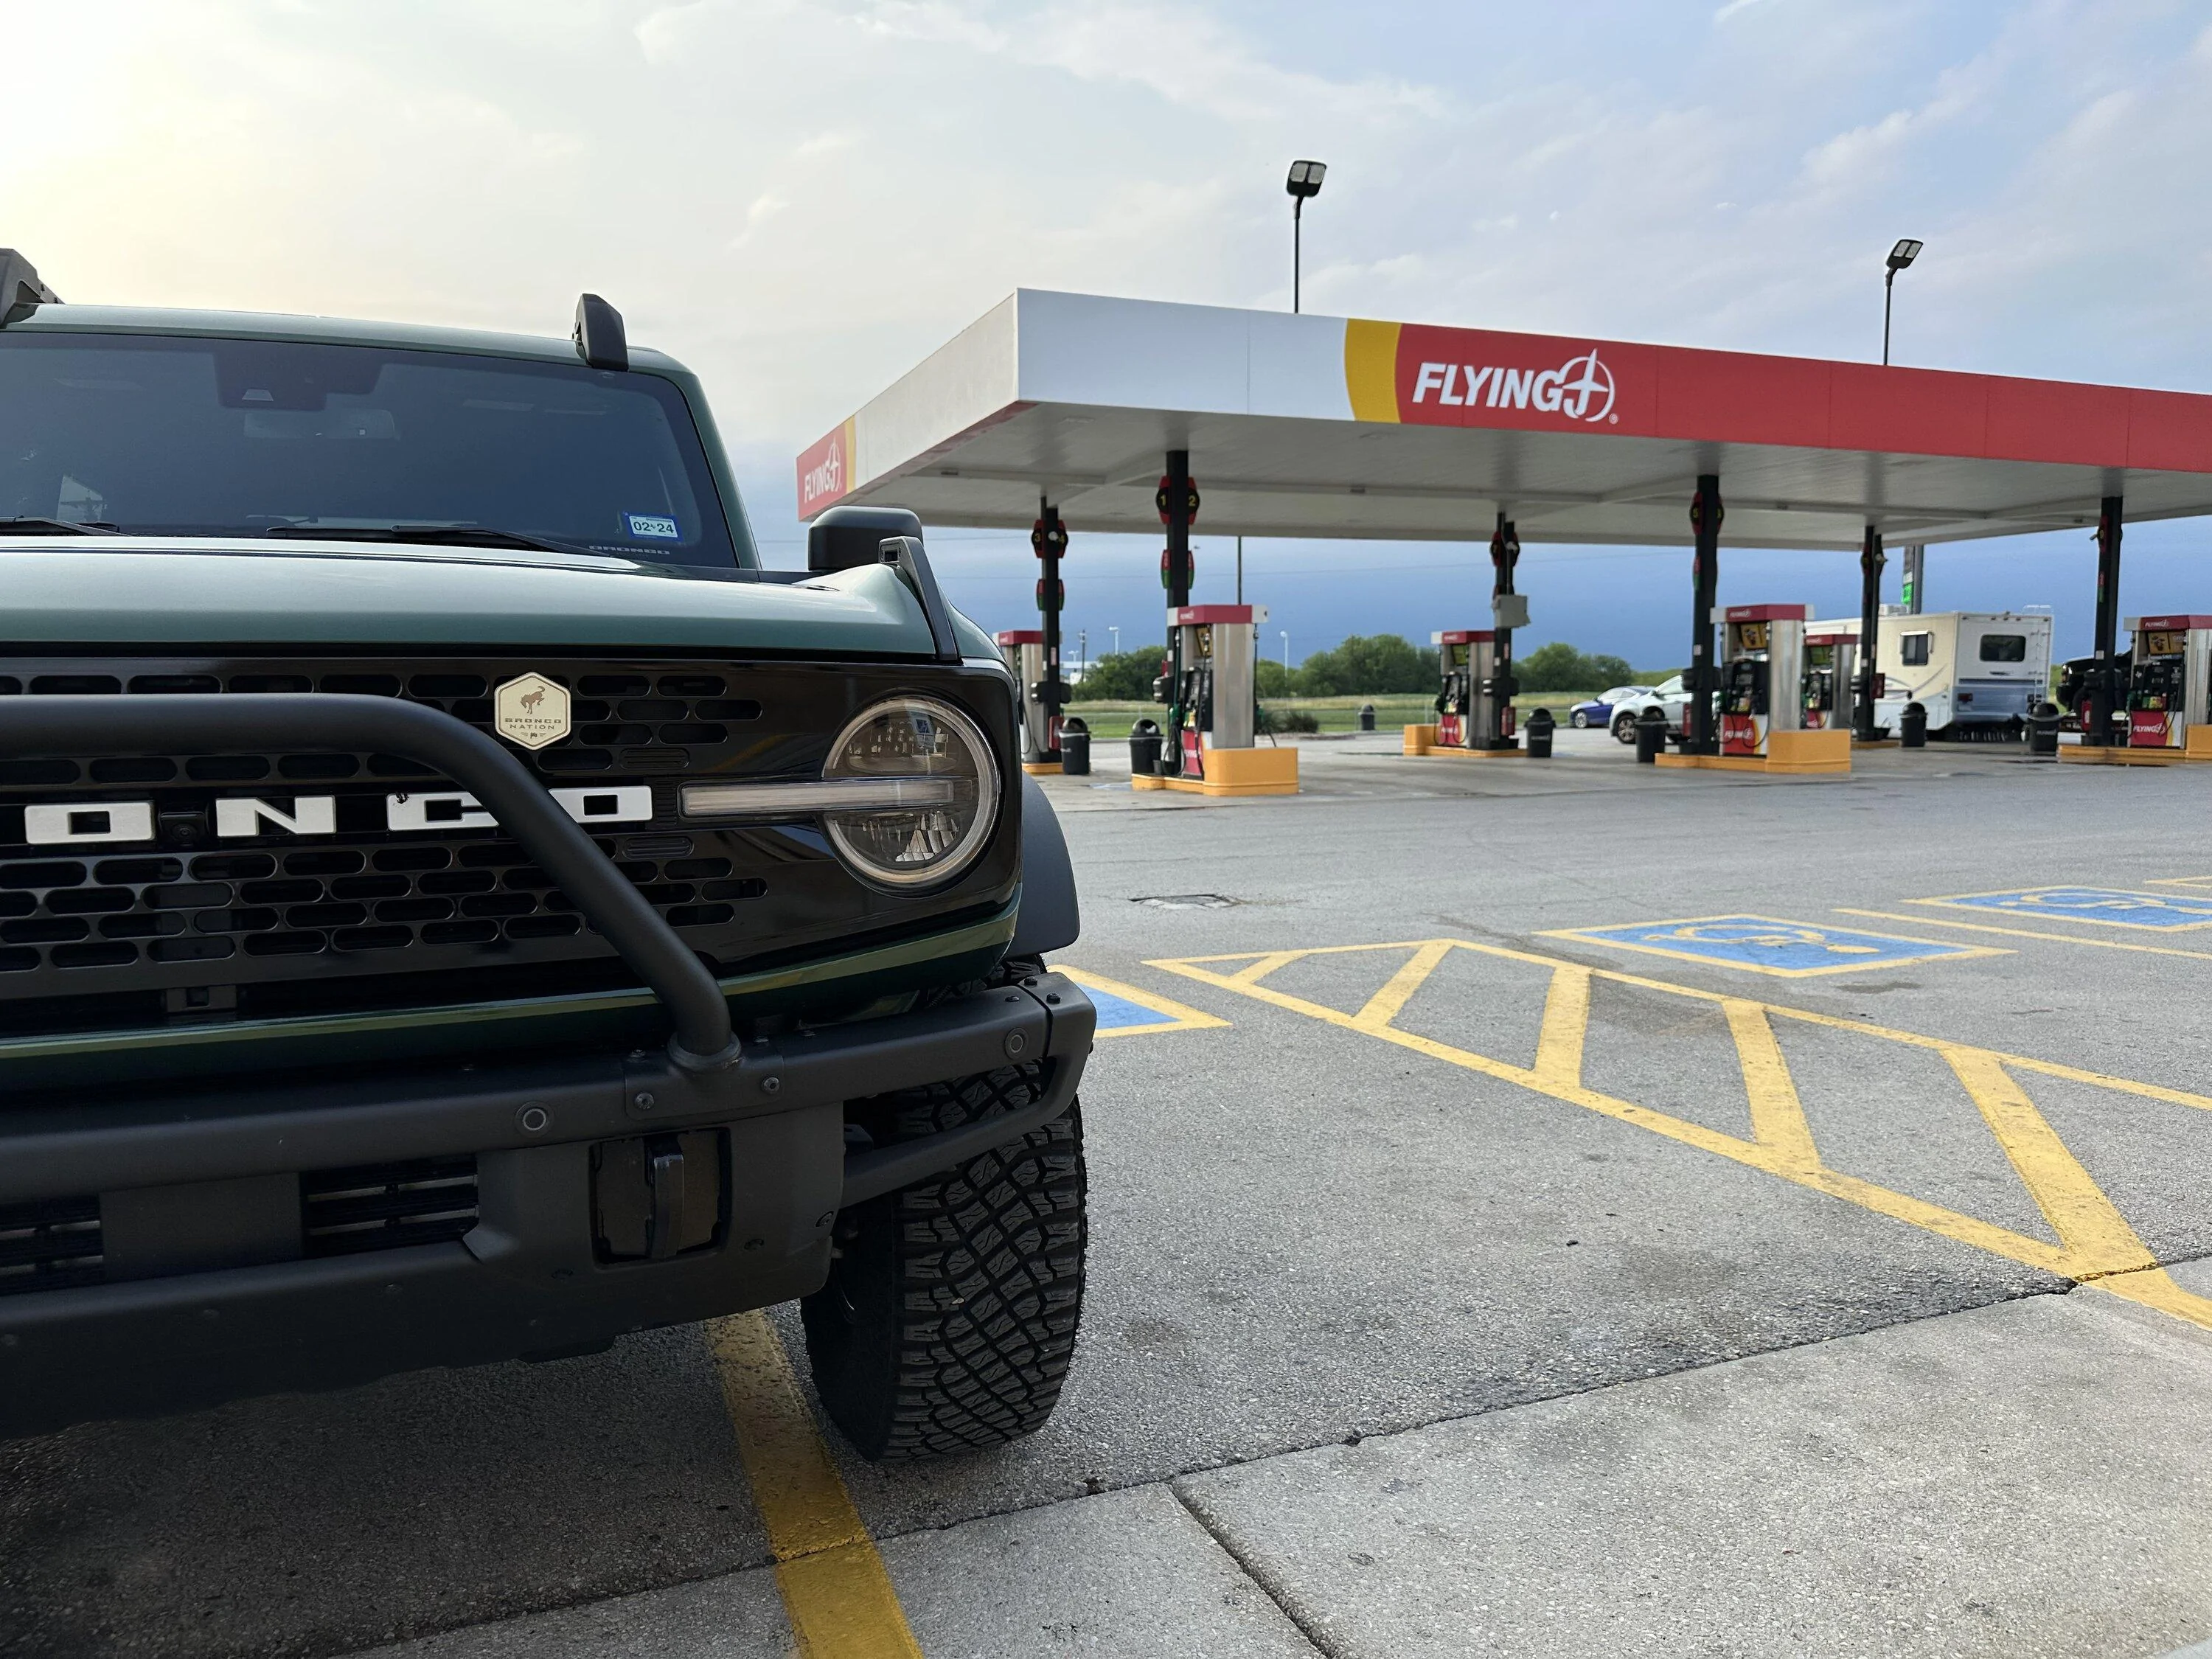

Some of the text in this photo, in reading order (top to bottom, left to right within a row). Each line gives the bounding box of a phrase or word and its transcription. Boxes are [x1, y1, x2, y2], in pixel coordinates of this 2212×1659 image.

[1160, 494, 1166, 506] 1
[1188, 495, 1196, 507] 2
[633, 521, 674, 533] 02 24
[1034, 532, 1041, 543] 3
